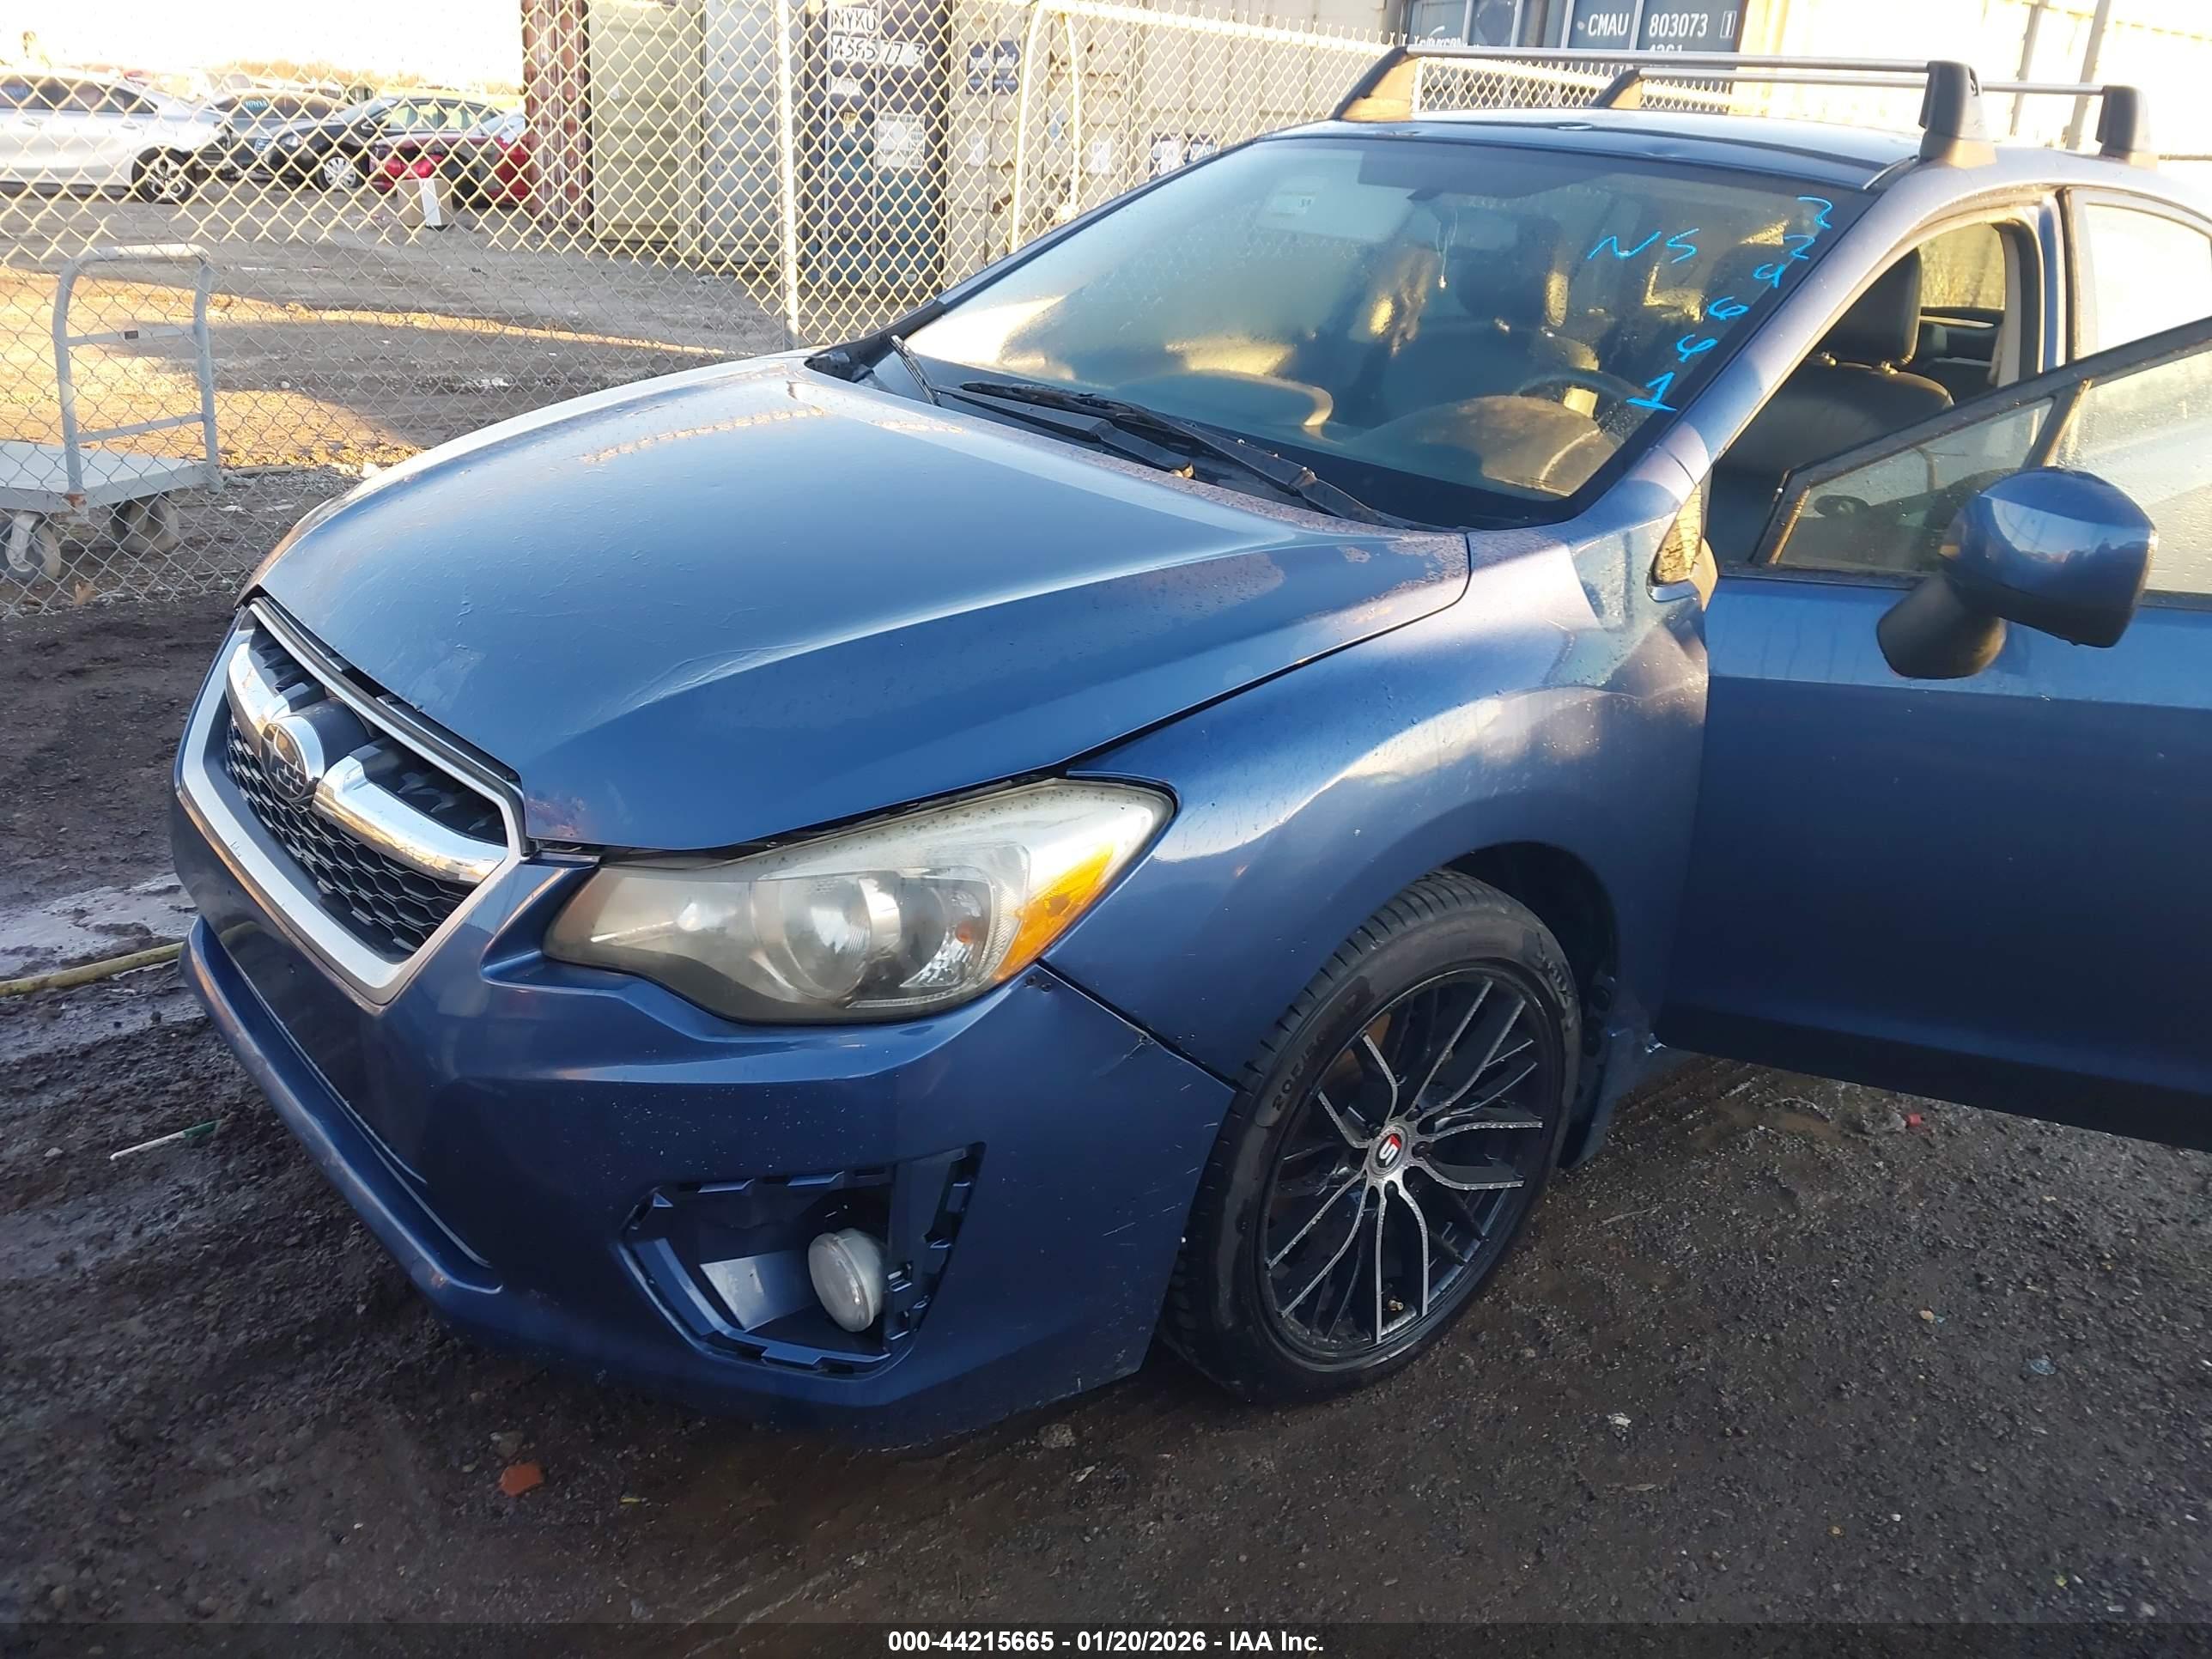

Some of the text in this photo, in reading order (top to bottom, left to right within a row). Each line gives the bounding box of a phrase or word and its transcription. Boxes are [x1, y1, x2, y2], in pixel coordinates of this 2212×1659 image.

[1588, 12, 1735, 38] CMAU 803073 1
